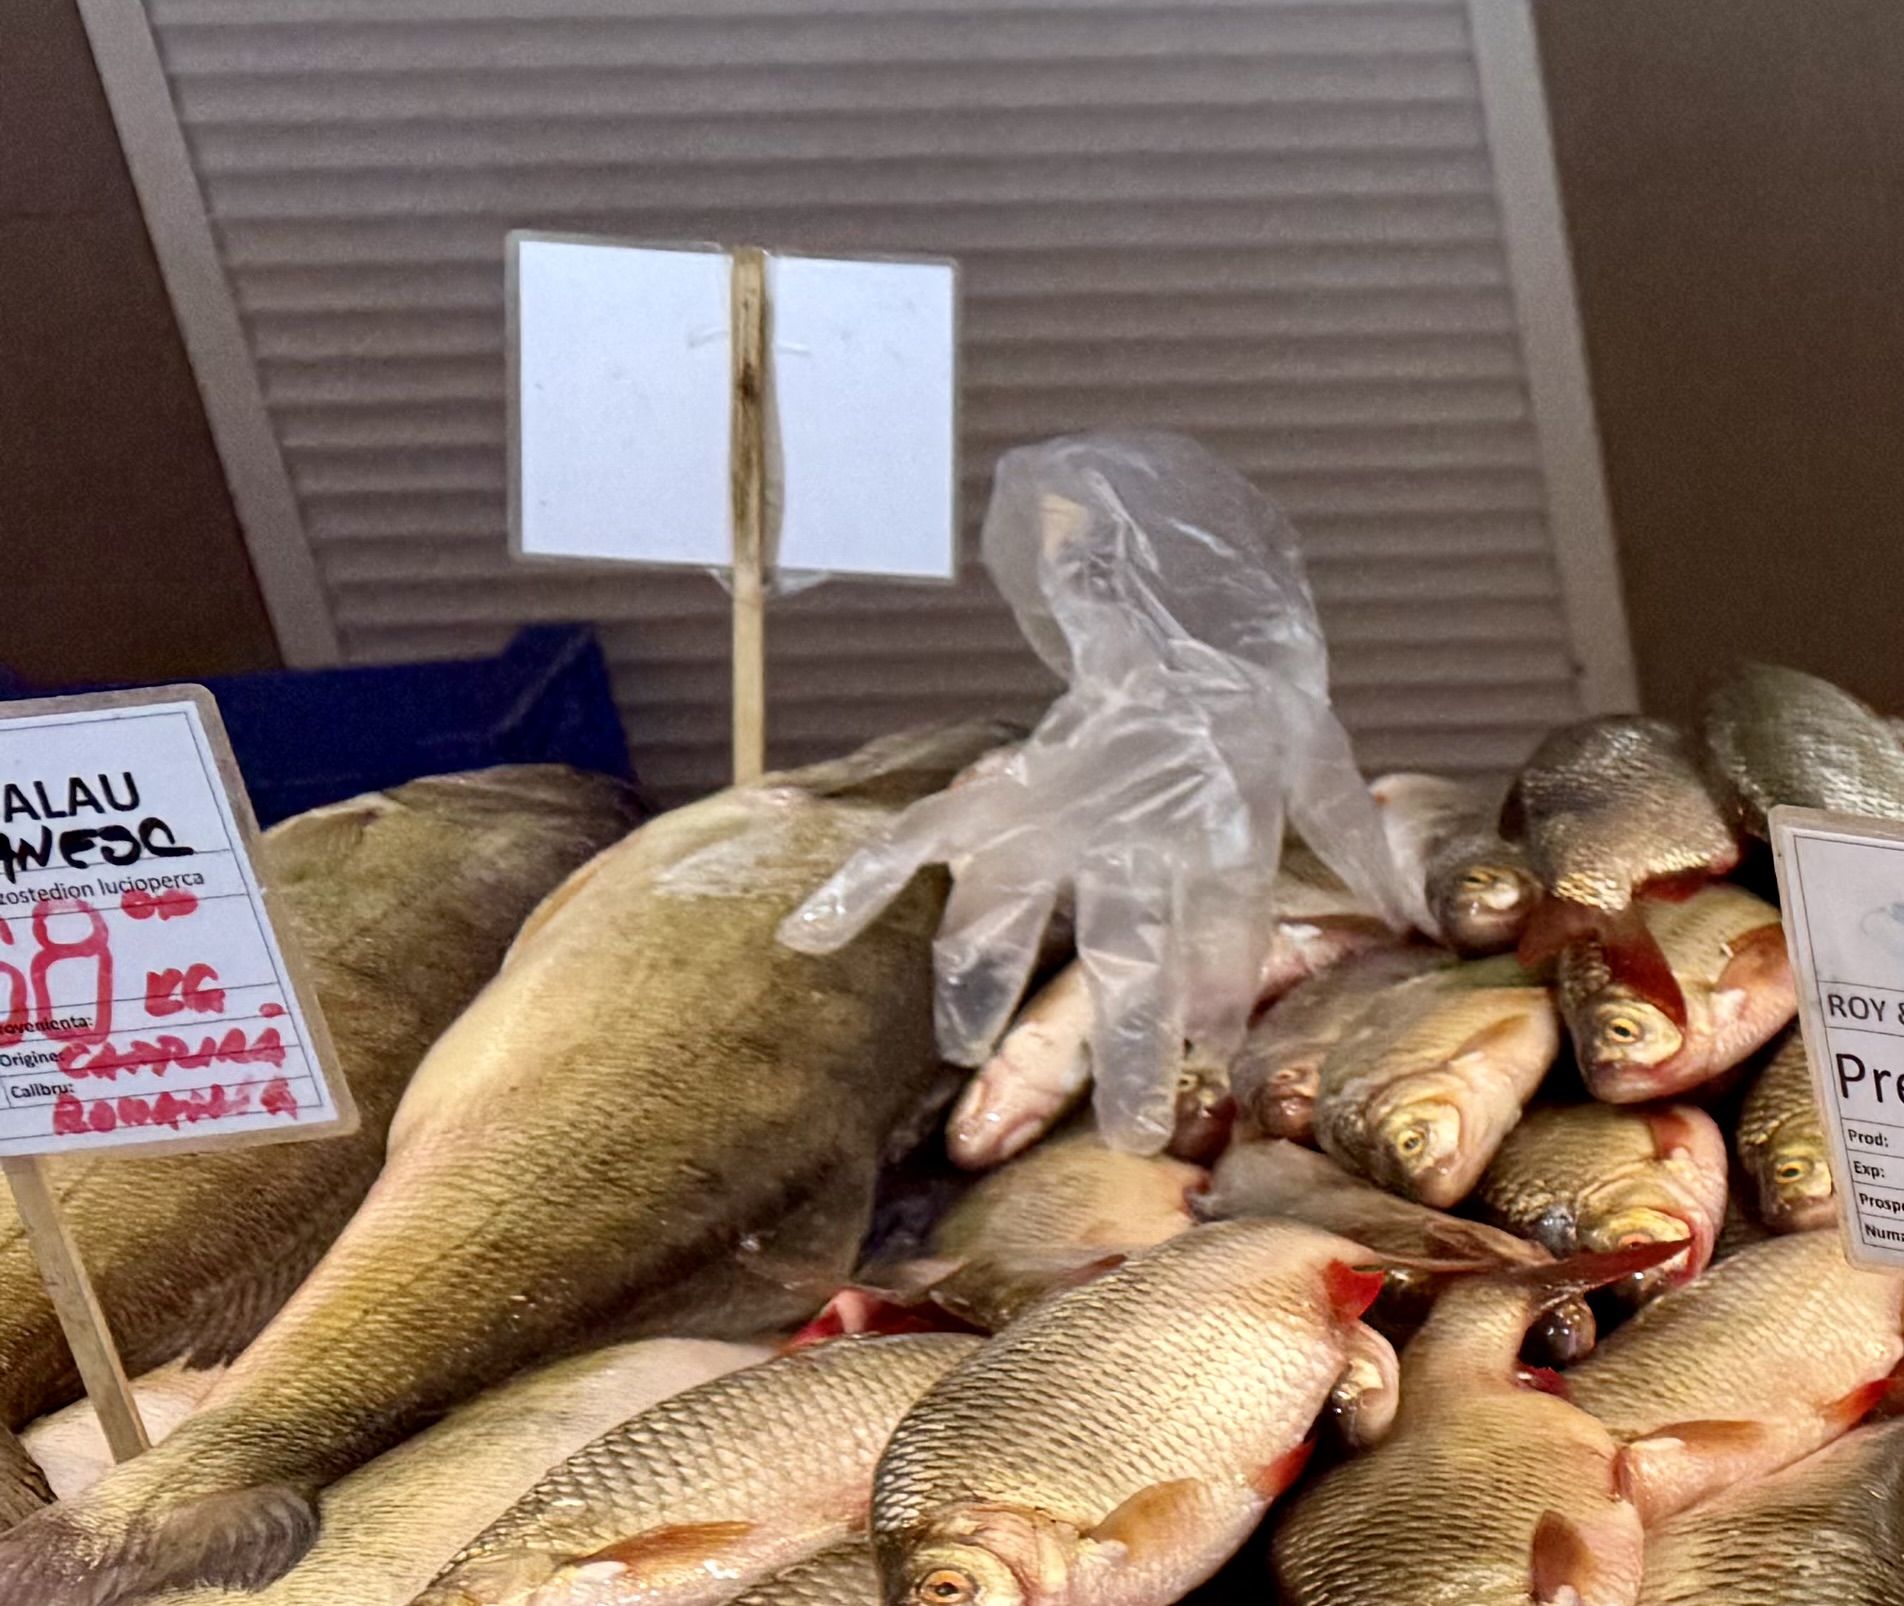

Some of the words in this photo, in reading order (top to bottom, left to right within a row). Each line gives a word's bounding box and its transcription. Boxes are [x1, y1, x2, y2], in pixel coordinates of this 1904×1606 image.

[98, 872, 205, 896] lucioperca
[1827, 993, 1886, 1022] ROY
[11, 1081, 75, 1098] Calibru:
[1847, 1128, 1889, 1147] Prod:
[1853, 1160, 1885, 1179] Exp:
